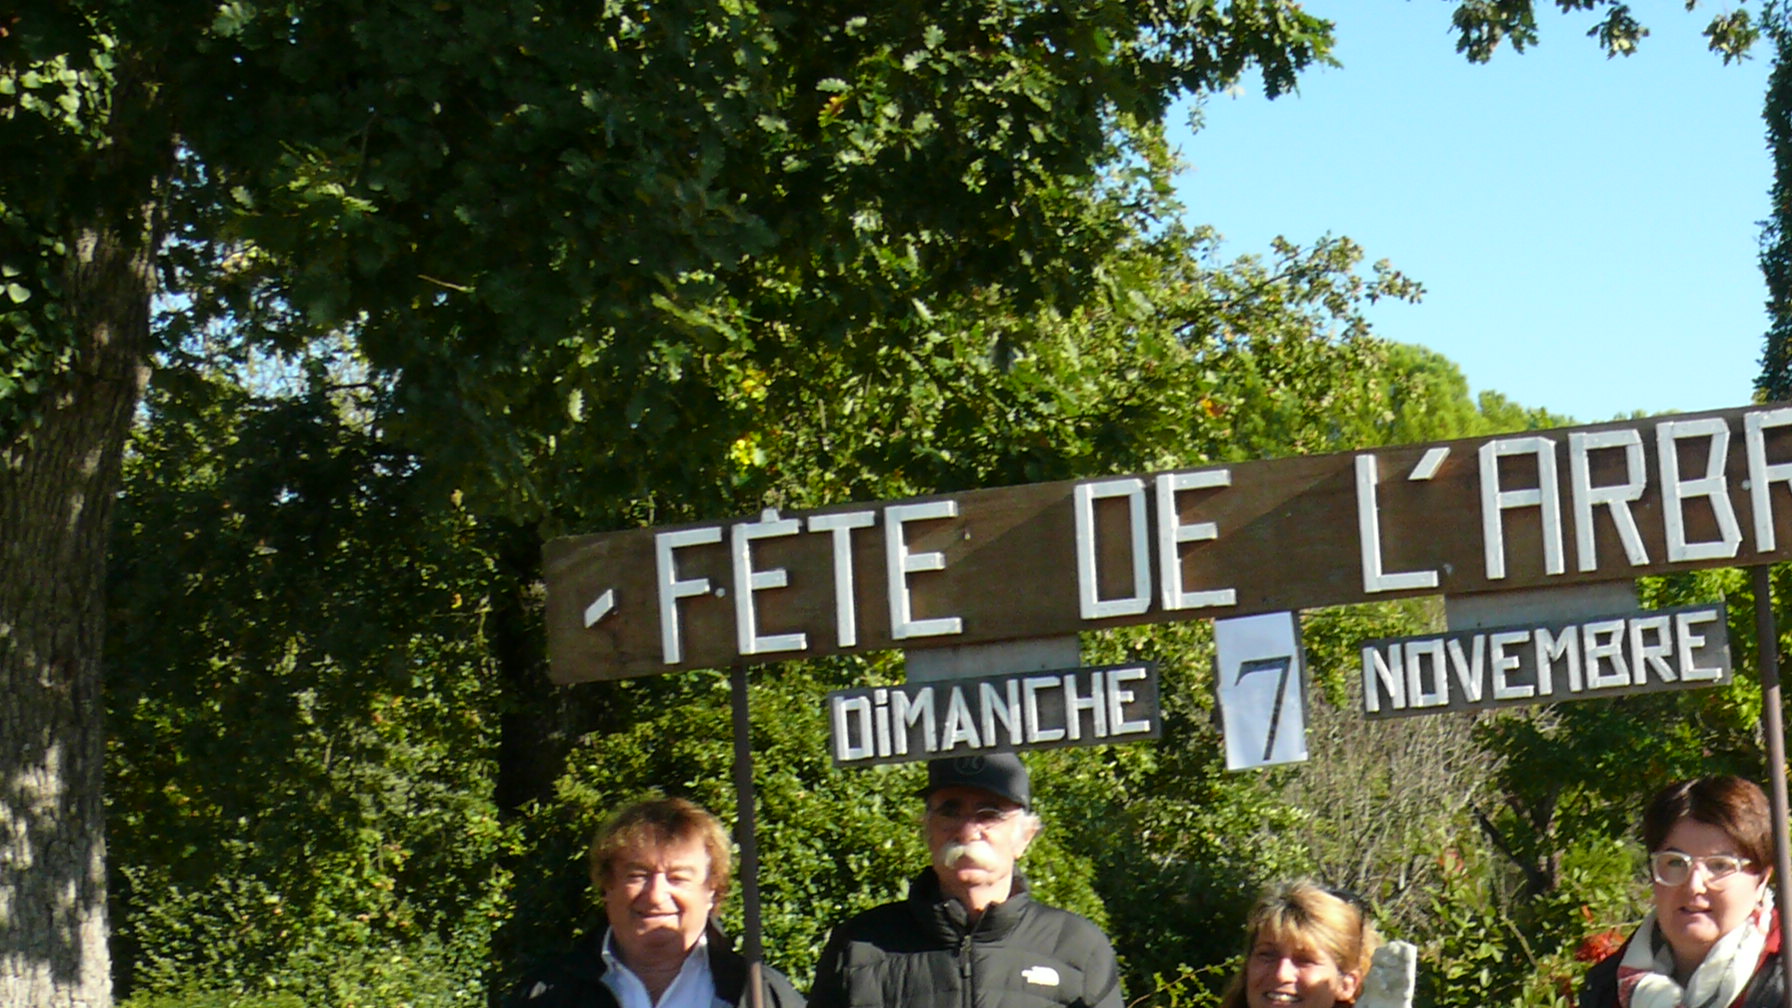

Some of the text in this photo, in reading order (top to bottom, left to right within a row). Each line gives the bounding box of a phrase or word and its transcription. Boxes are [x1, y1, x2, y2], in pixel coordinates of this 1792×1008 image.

[1074, 469, 1237, 619] DE
[1233, 655, 1291, 763] 7
[1361, 609, 1723, 713] NOVEMBRE
